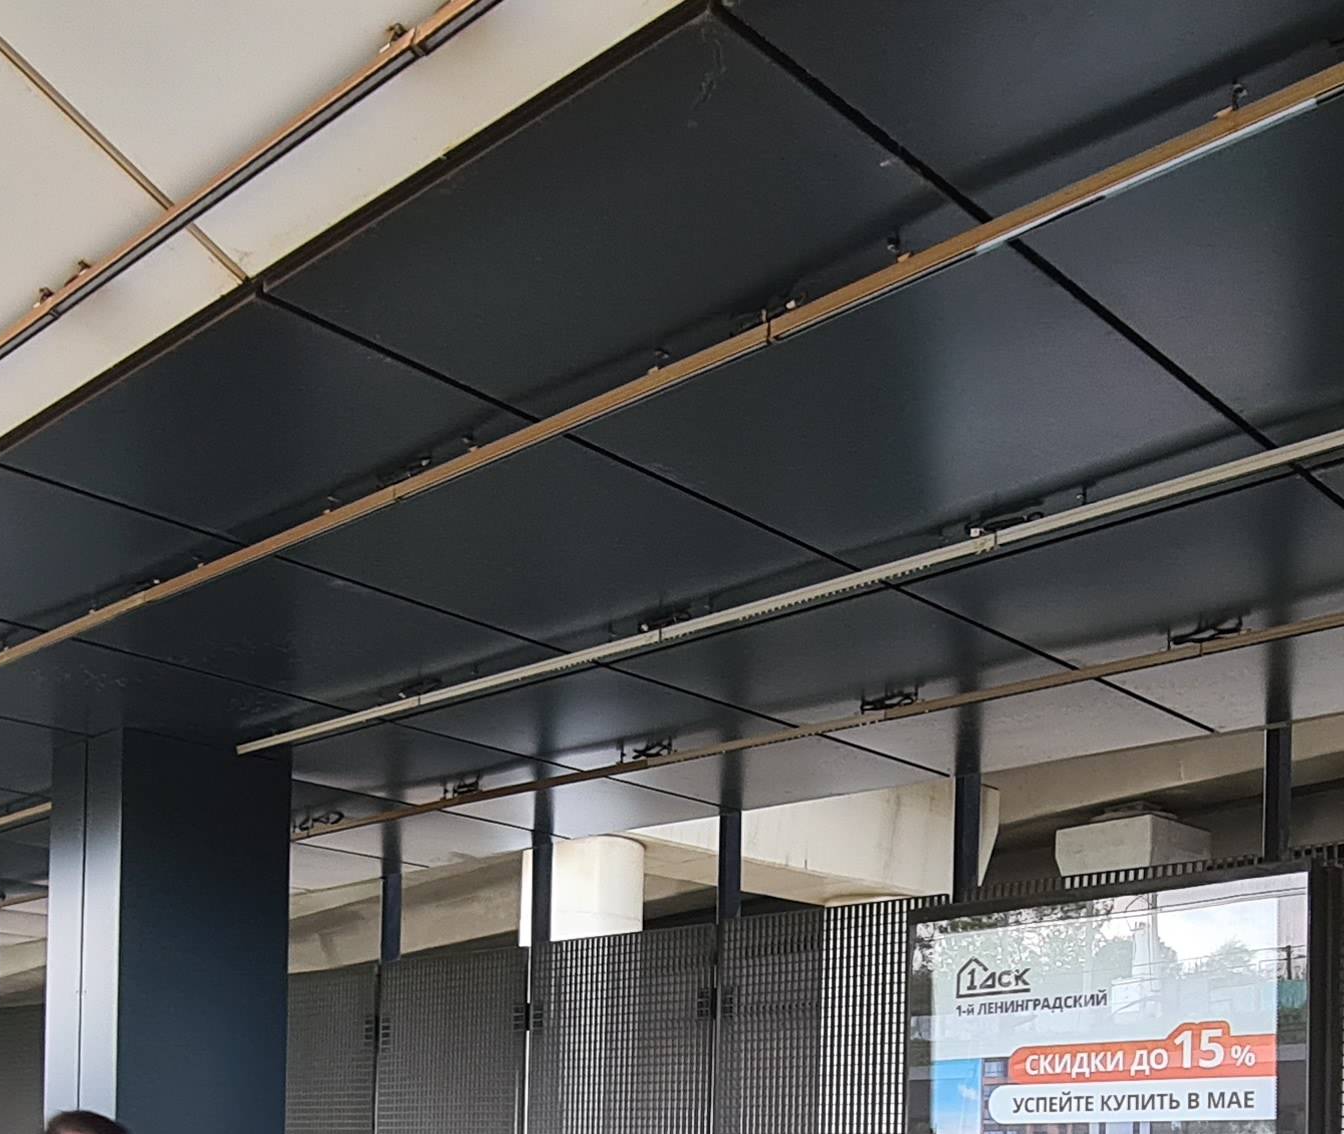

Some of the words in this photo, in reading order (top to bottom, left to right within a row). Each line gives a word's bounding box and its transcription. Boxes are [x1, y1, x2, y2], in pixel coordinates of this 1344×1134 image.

[956, 1003, 975, 1017] 1-й
[976, 989, 1108, 1016] ЛЕНИНГРАДСКИЙ
[1024, 1049, 1124, 1079] СКИДКИ
[1129, 1048, 1169, 1077] ДО
[1012, 1091, 1094, 1114] УСПЕЙТЕ
[1100, 1093, 1181, 1113] КУПИТЬ
[1187, 1092, 1200, 1110] В
[1207, 1090, 1256, 1109] МАЕ
